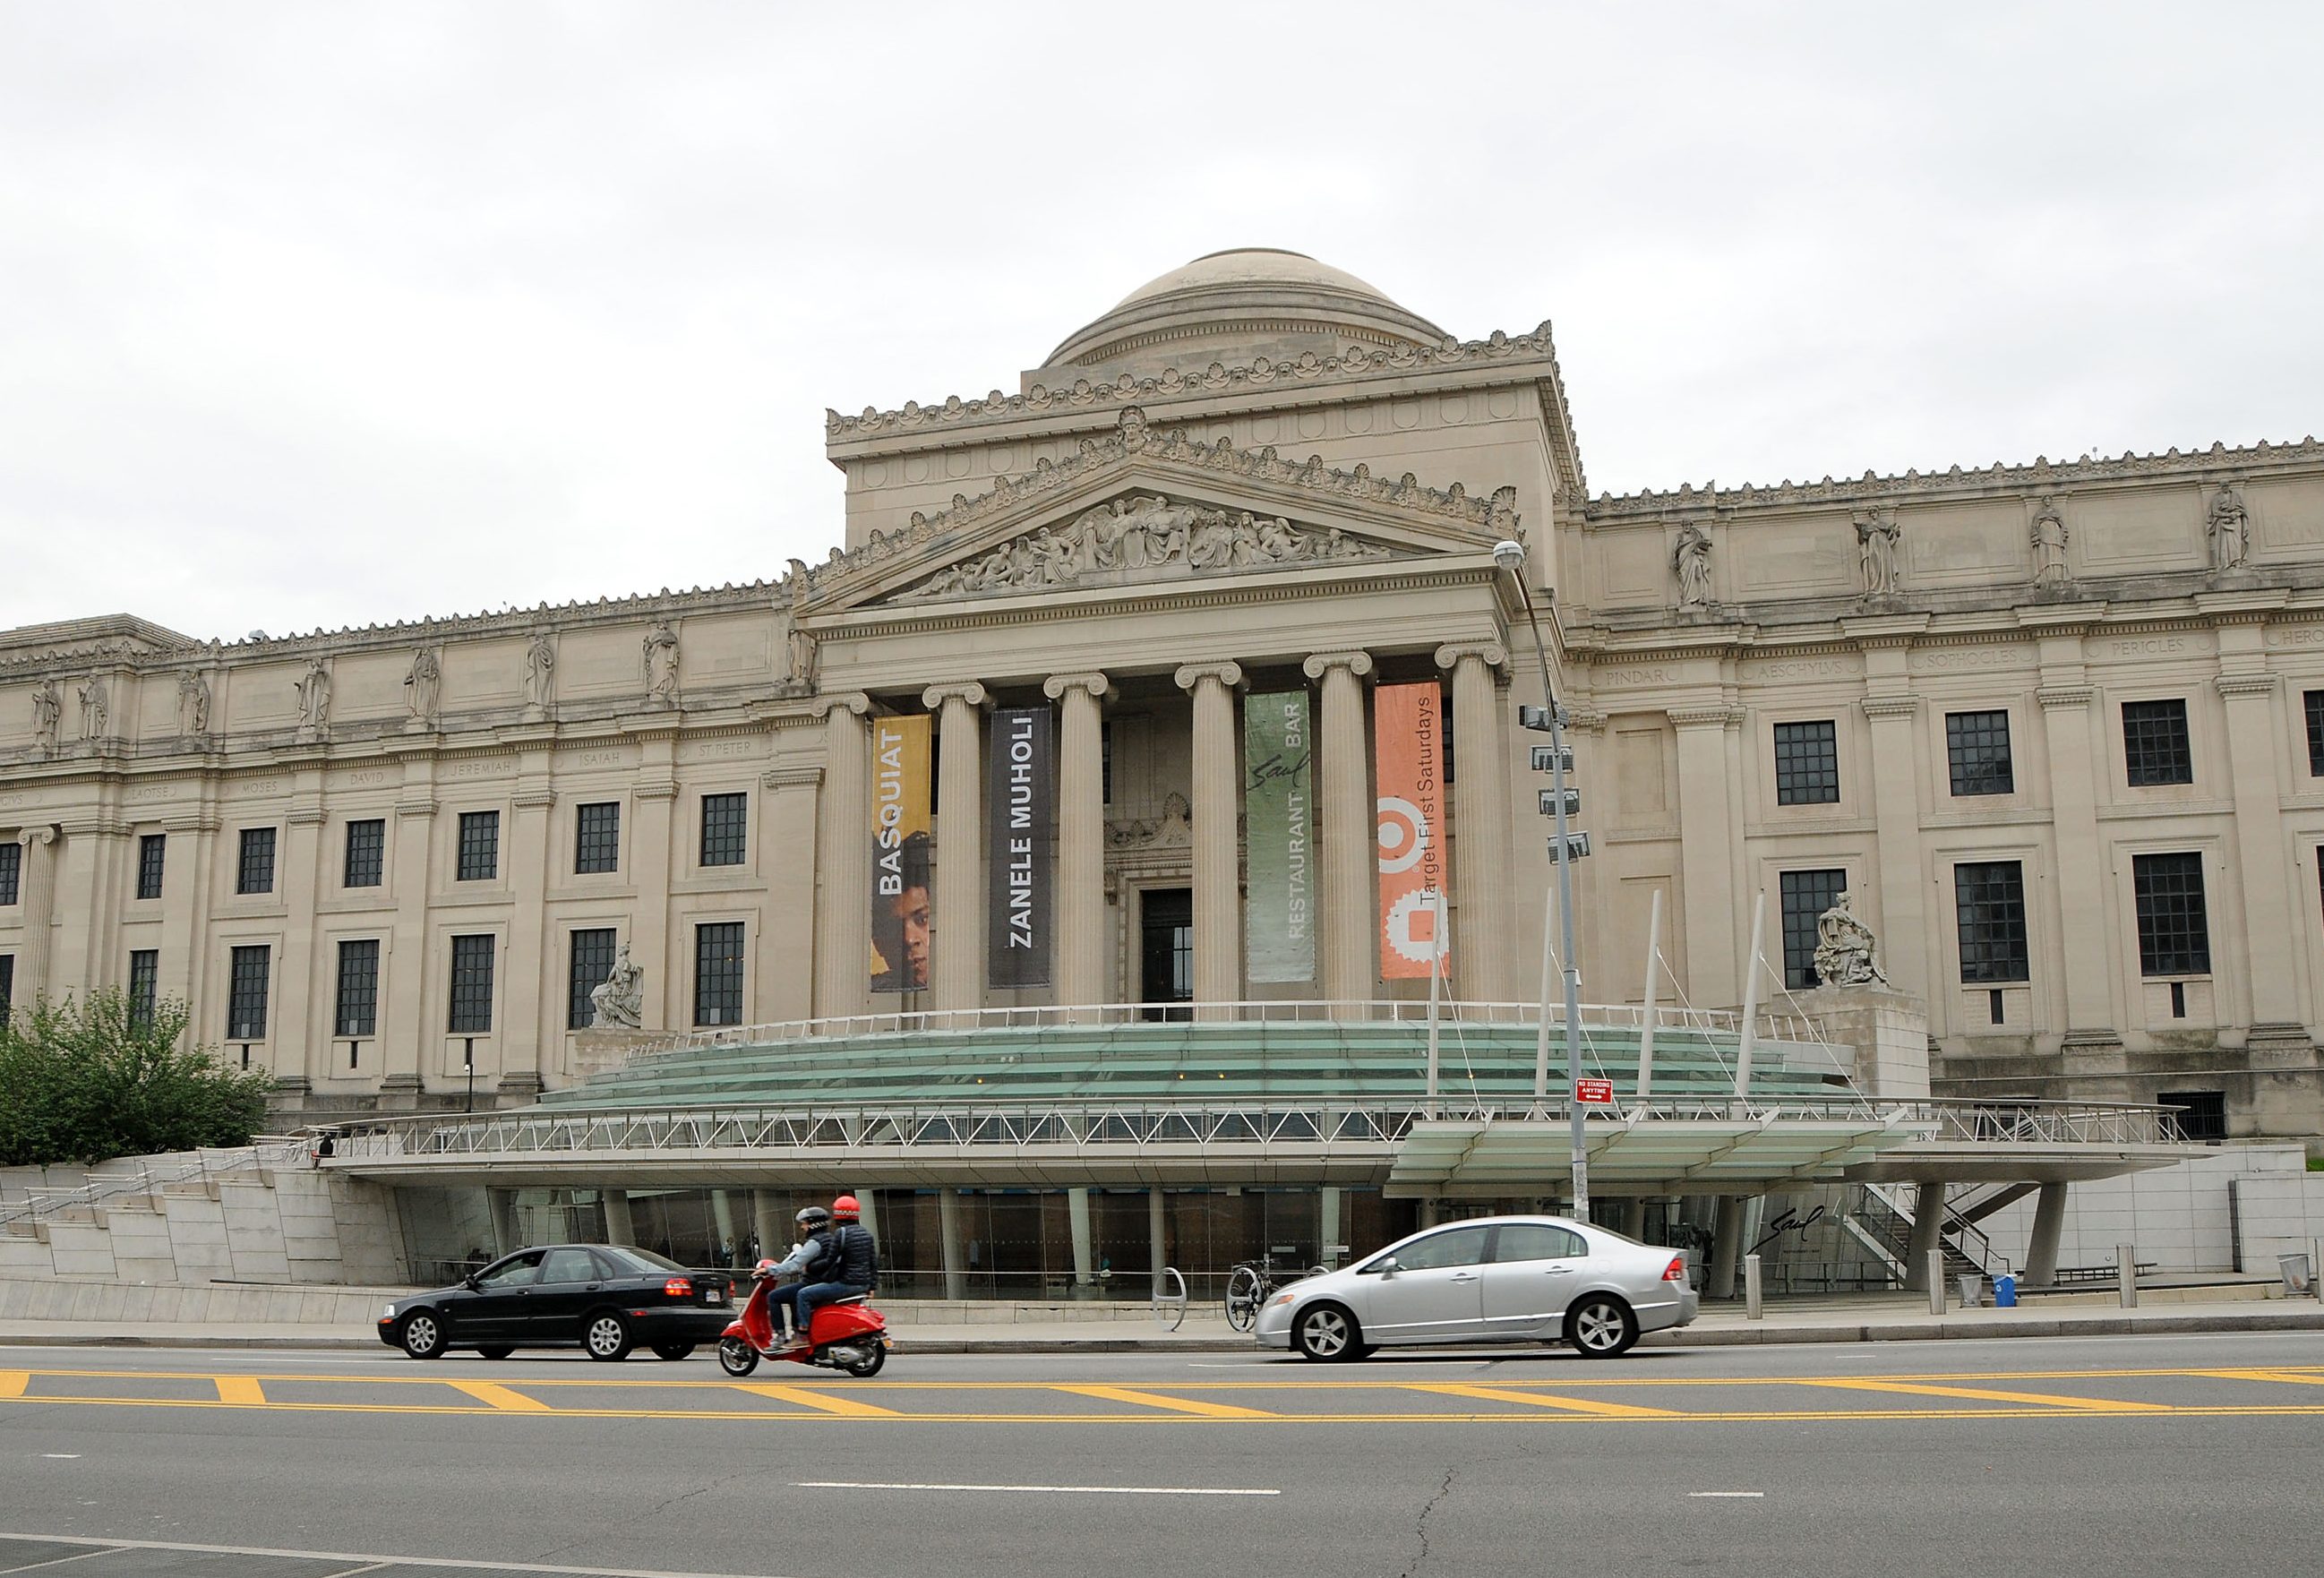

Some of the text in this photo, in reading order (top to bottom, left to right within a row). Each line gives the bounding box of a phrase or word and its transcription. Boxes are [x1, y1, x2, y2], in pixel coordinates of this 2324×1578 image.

[2112, 638, 2185, 656] PERICLES
[1927, 649, 2017, 667] SOPHOCLES
[1606, 669, 1668, 685] PINDAR
[1758, 661, 1842, 679] AESCHYLVS
[1284, 703, 1301, 747] BAR
[579, 751, 620, 767] ISAIAH
[450, 761, 510, 776] JEREMIAH
[243, 781, 278, 793] MOSES
[350, 772, 384, 785] DAVID
[132, 786, 168, 800] LAOTSE
[1415, 697, 1439, 905] Target First Saturdays
[879, 728, 904, 896] BASQUIAT
[1010, 717, 1032, 948] ZANELE MUHOLI
[1289, 792, 1305, 939] RESTAURANT
